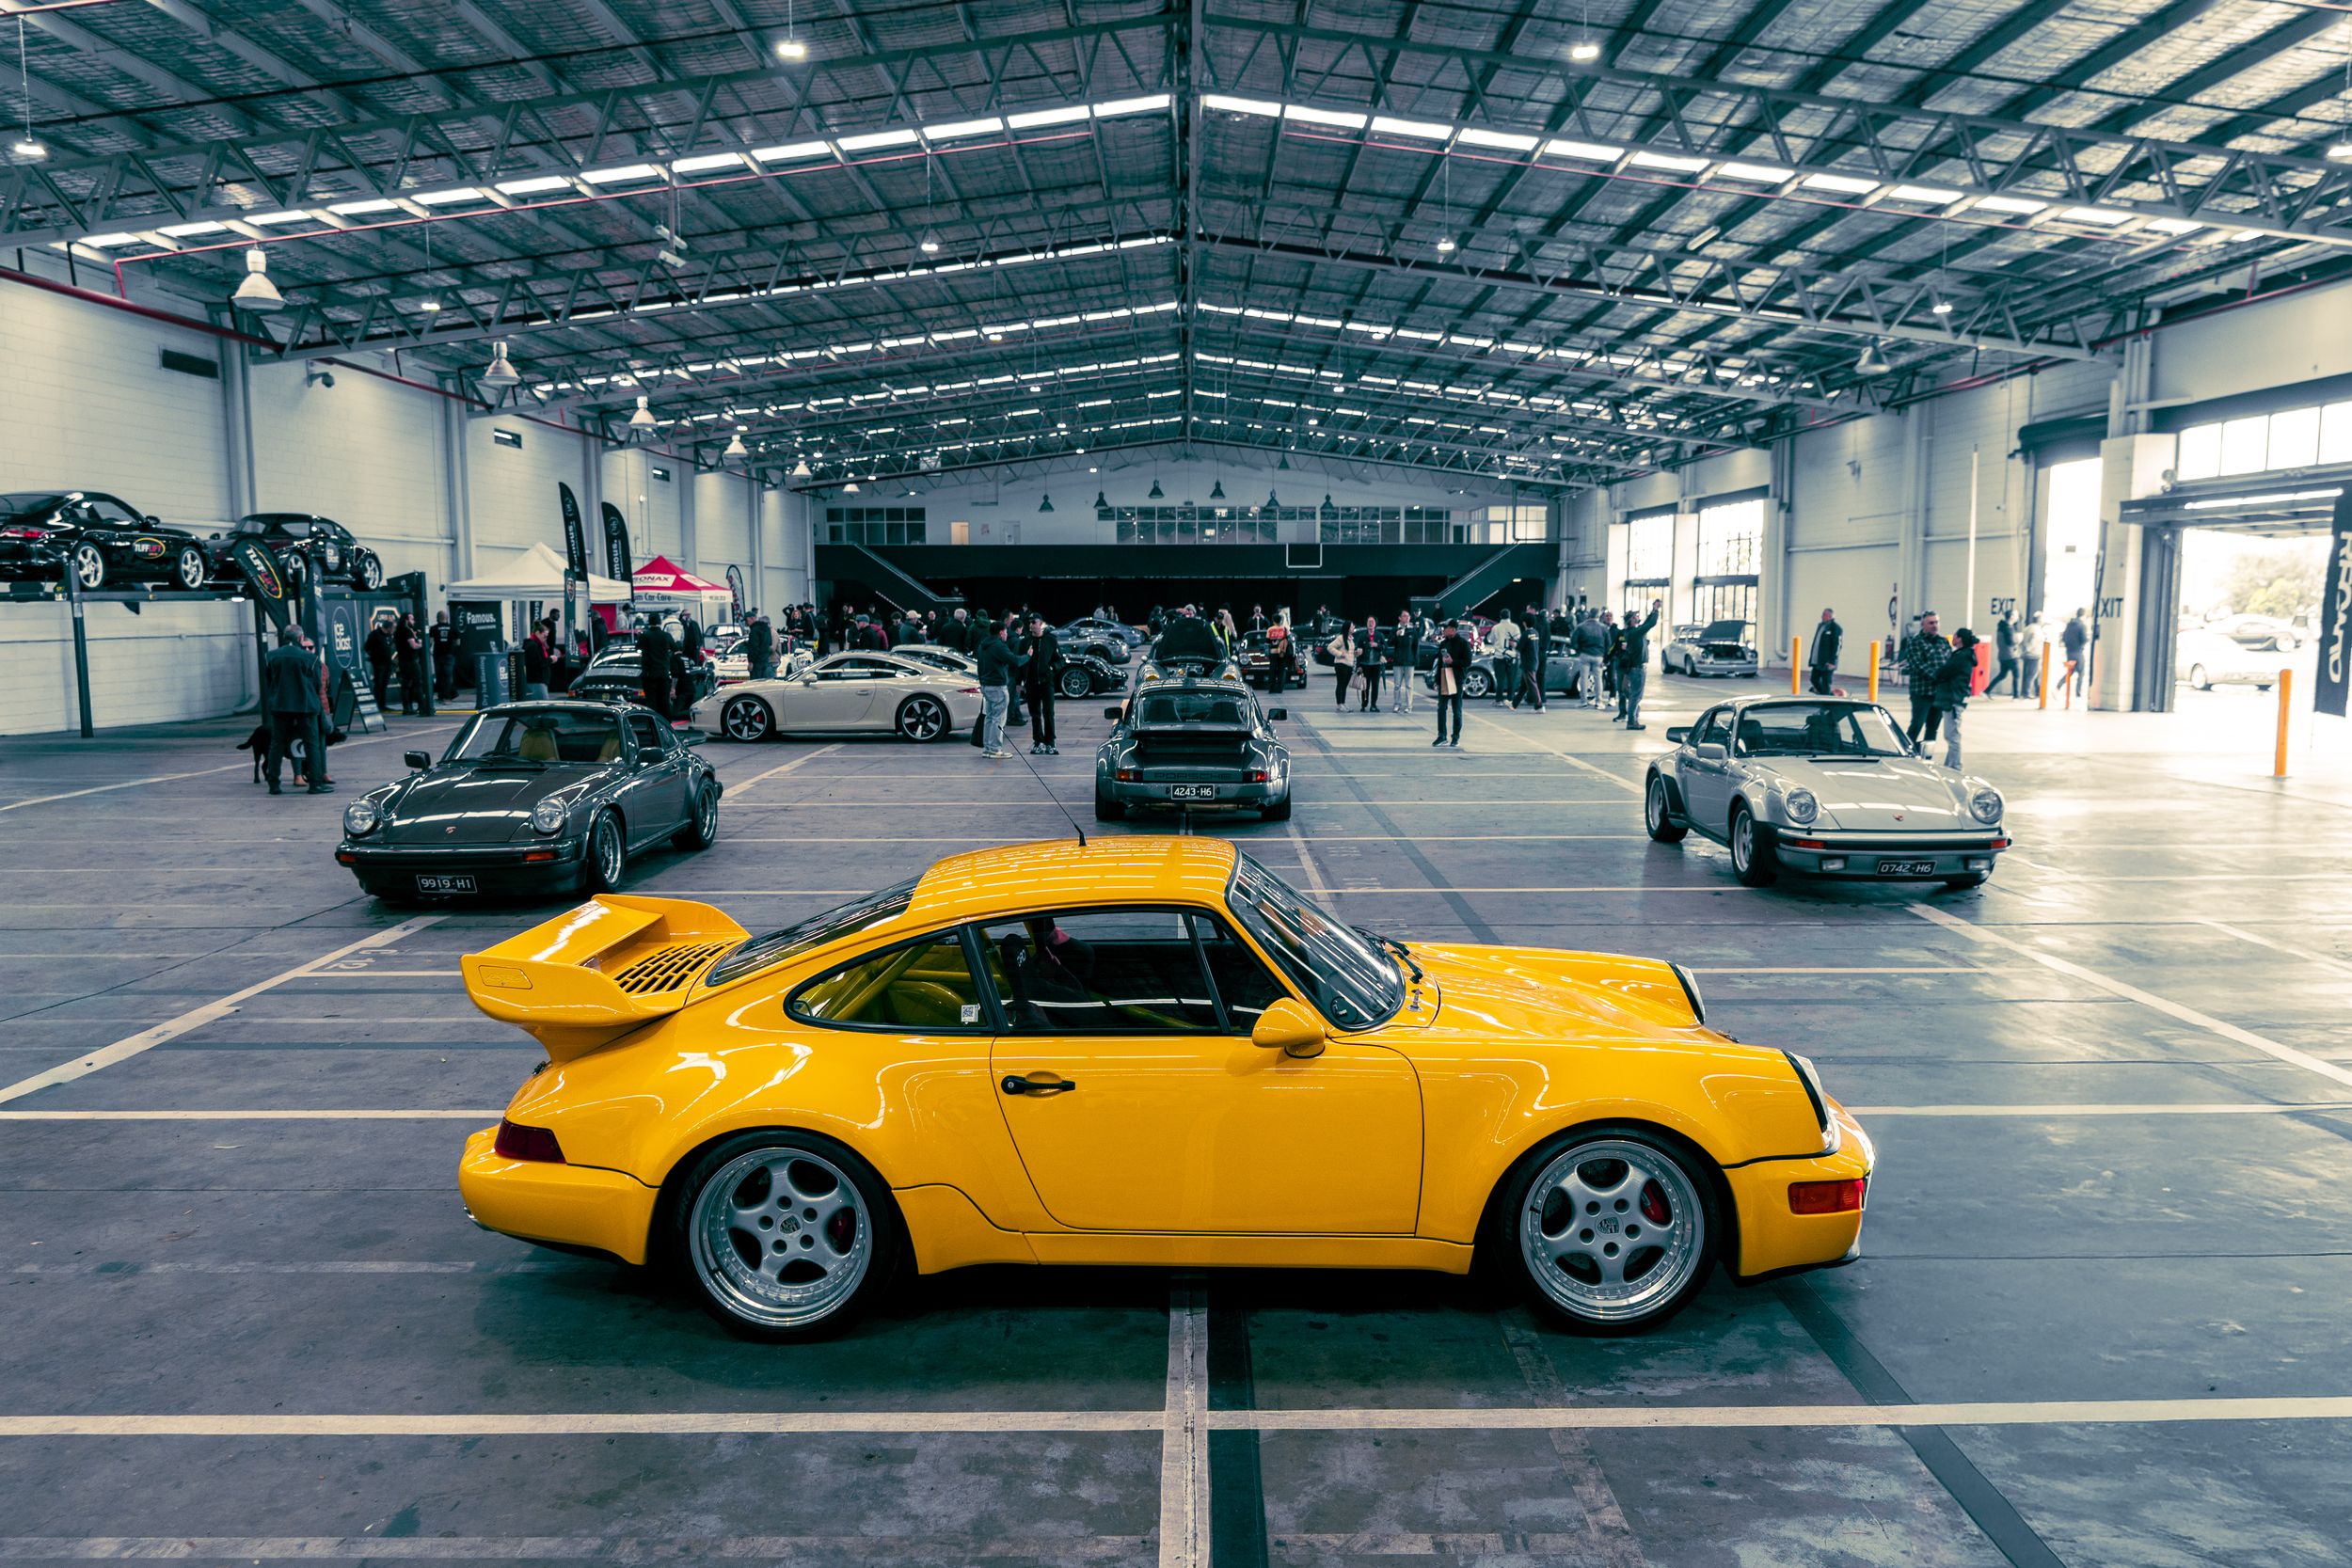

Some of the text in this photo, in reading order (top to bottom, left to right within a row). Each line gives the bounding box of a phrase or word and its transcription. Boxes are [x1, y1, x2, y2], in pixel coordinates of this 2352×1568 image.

[612, 539, 622, 580] amous.
[1991, 598, 2016, 615] EXIT
[2099, 597, 2124, 618] XIT
[334, 620, 345, 636] ice
[335, 636, 353, 651] blast
